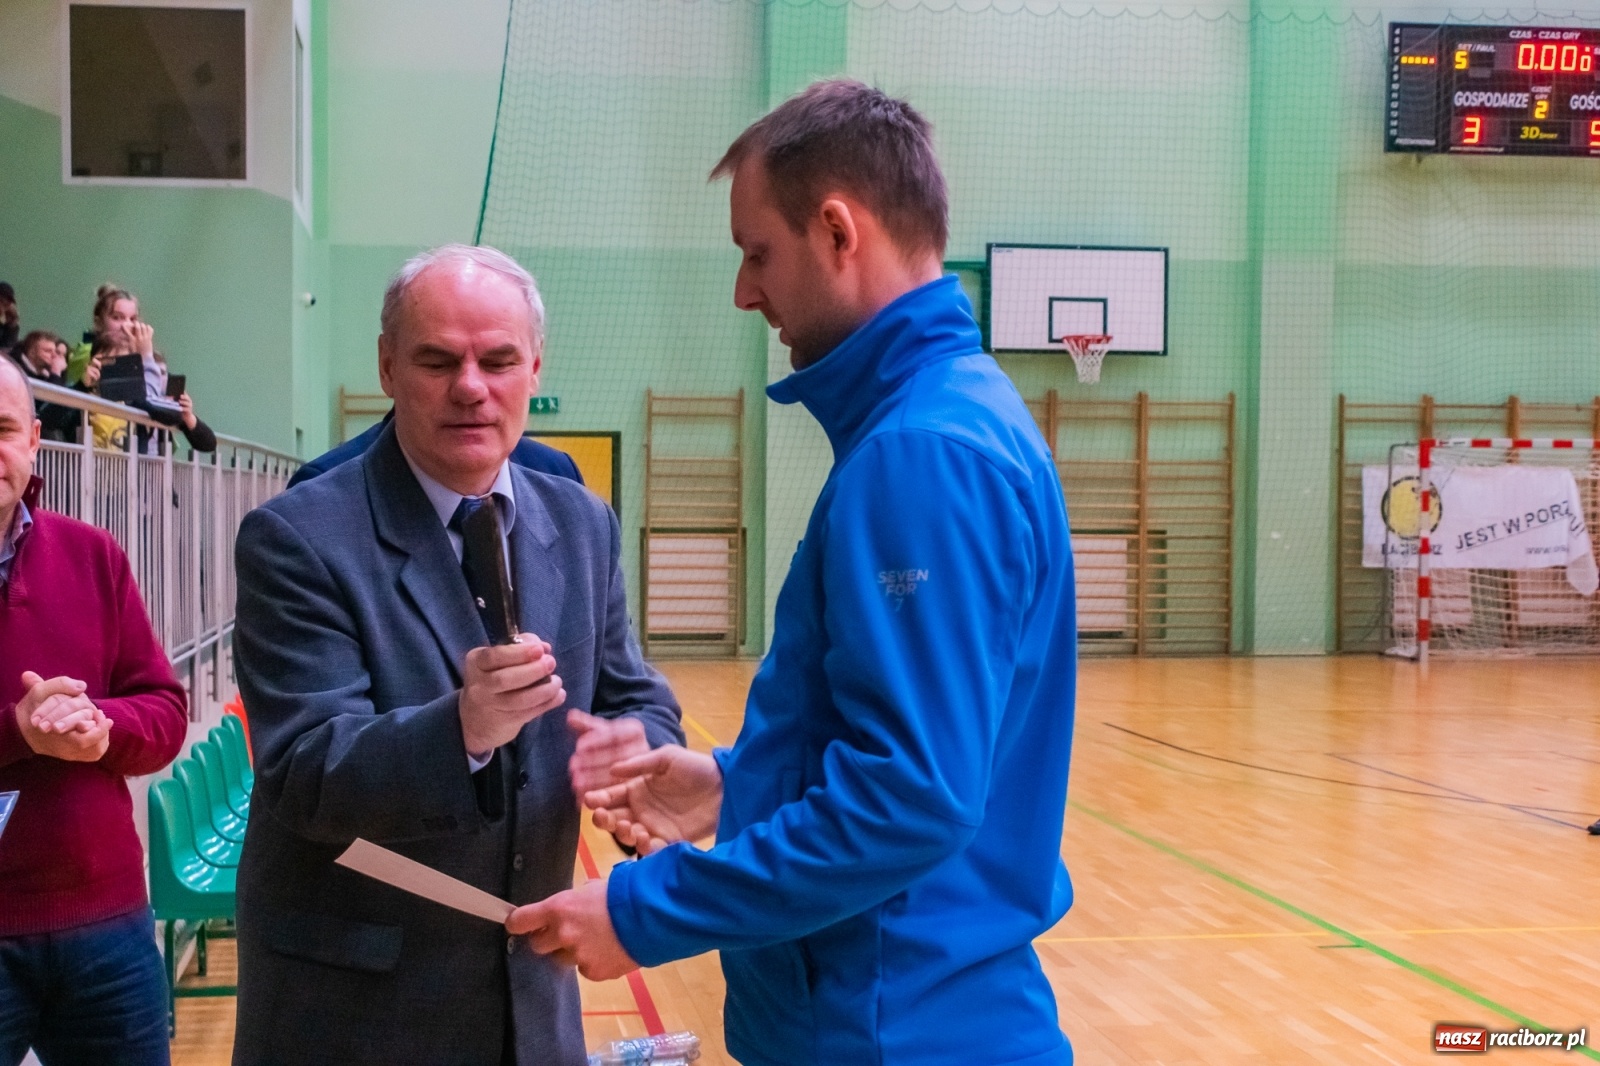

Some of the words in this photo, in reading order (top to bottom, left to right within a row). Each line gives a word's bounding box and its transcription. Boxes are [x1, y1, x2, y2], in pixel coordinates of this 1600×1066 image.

[1509, 30, 1532, 38] CZAS
[1539, 31, 1561, 39] CZAS
[1562, 32, 1580, 40] GRY
[1454, 50, 1468, 69] 5
[1453, 91, 1530, 108] GOSPODARZE
[1534, 100, 1549, 119] 2
[1463, 117, 1481, 144] 3
[1456, 523, 1497, 550] JEST
[1502, 517, 1521, 534] W
[878, 569, 929, 584] SEVEN
[885, 582, 917, 597] FOR
[894, 597, 904, 612] 7
